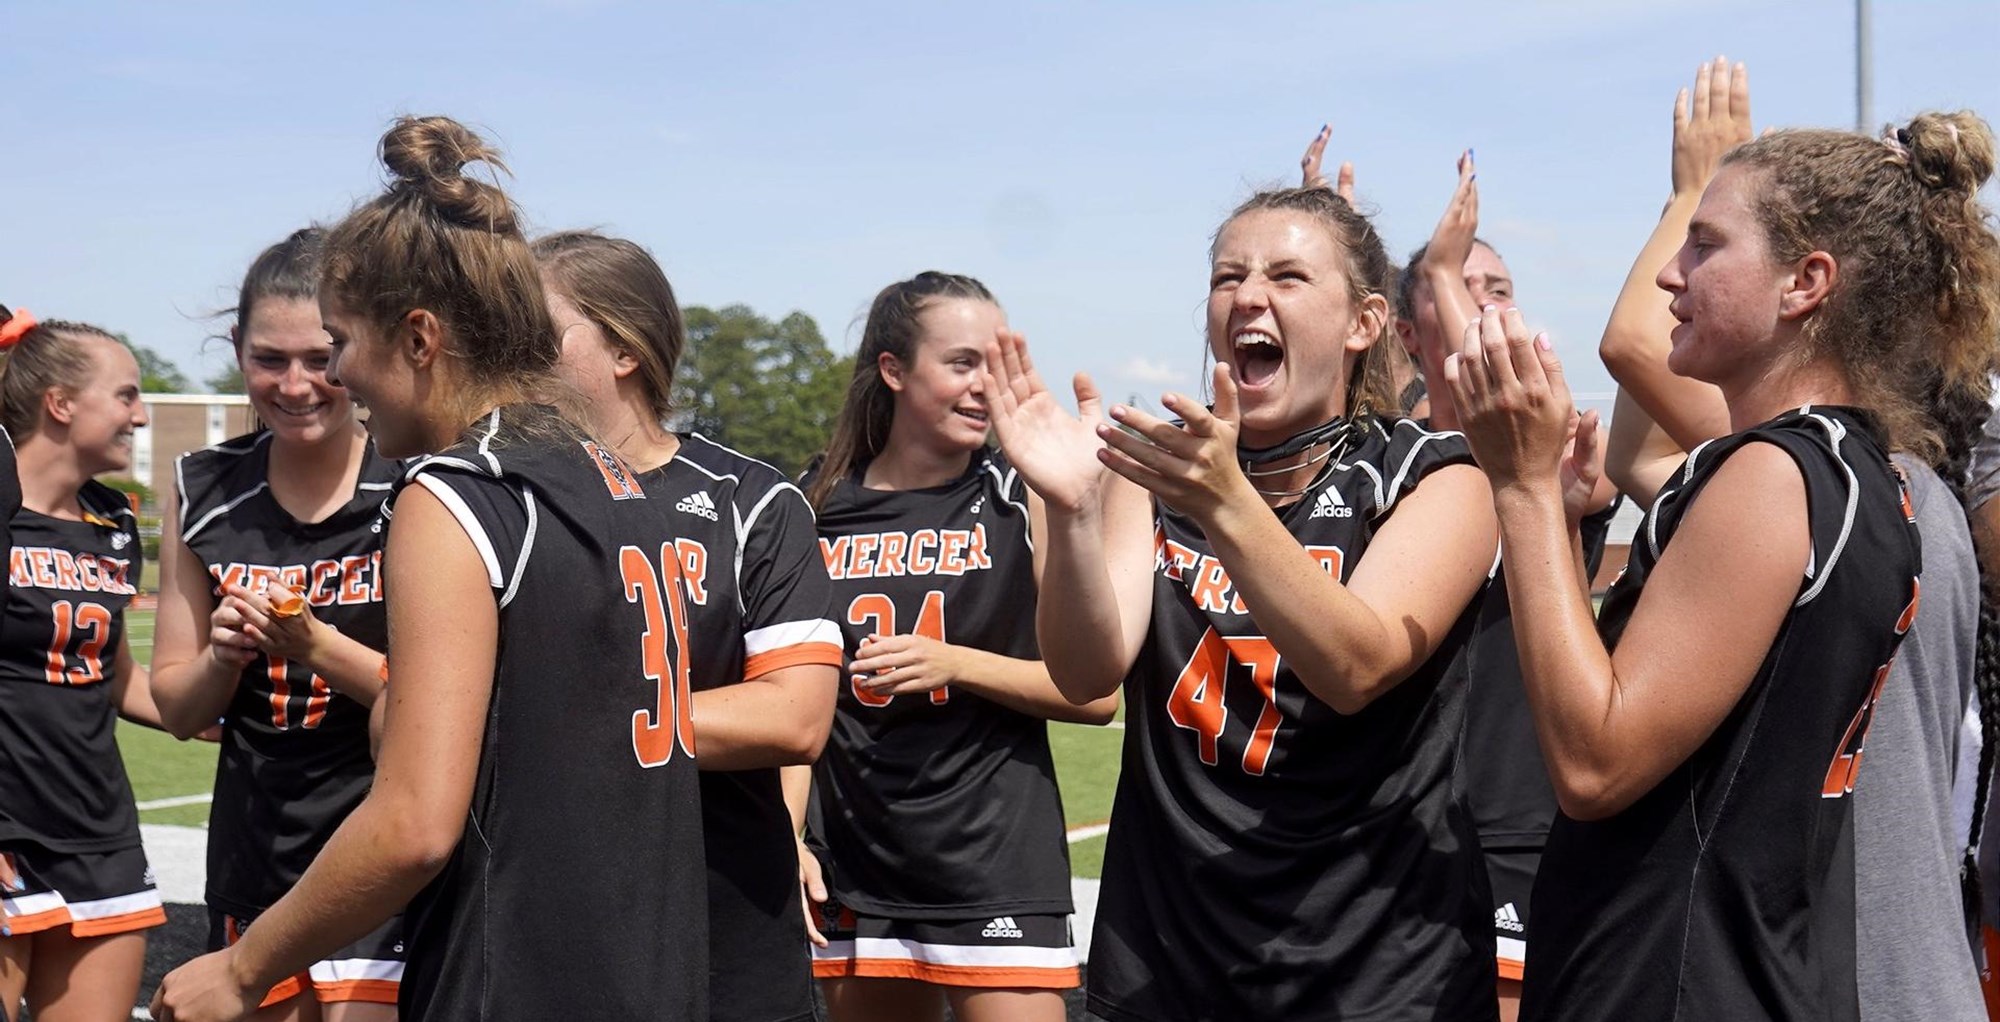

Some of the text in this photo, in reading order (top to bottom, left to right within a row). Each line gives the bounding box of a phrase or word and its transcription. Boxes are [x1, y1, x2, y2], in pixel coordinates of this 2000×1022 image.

[675, 502, 719, 522] adidas
[1308, 504, 1353, 520] didas
[9, 545, 137, 595] MERCER
[817, 522, 993, 580] MERCER
[45, 599, 112, 685] 13
[1166, 624, 1284, 777] 47
[981, 927, 1024, 939] adidas
